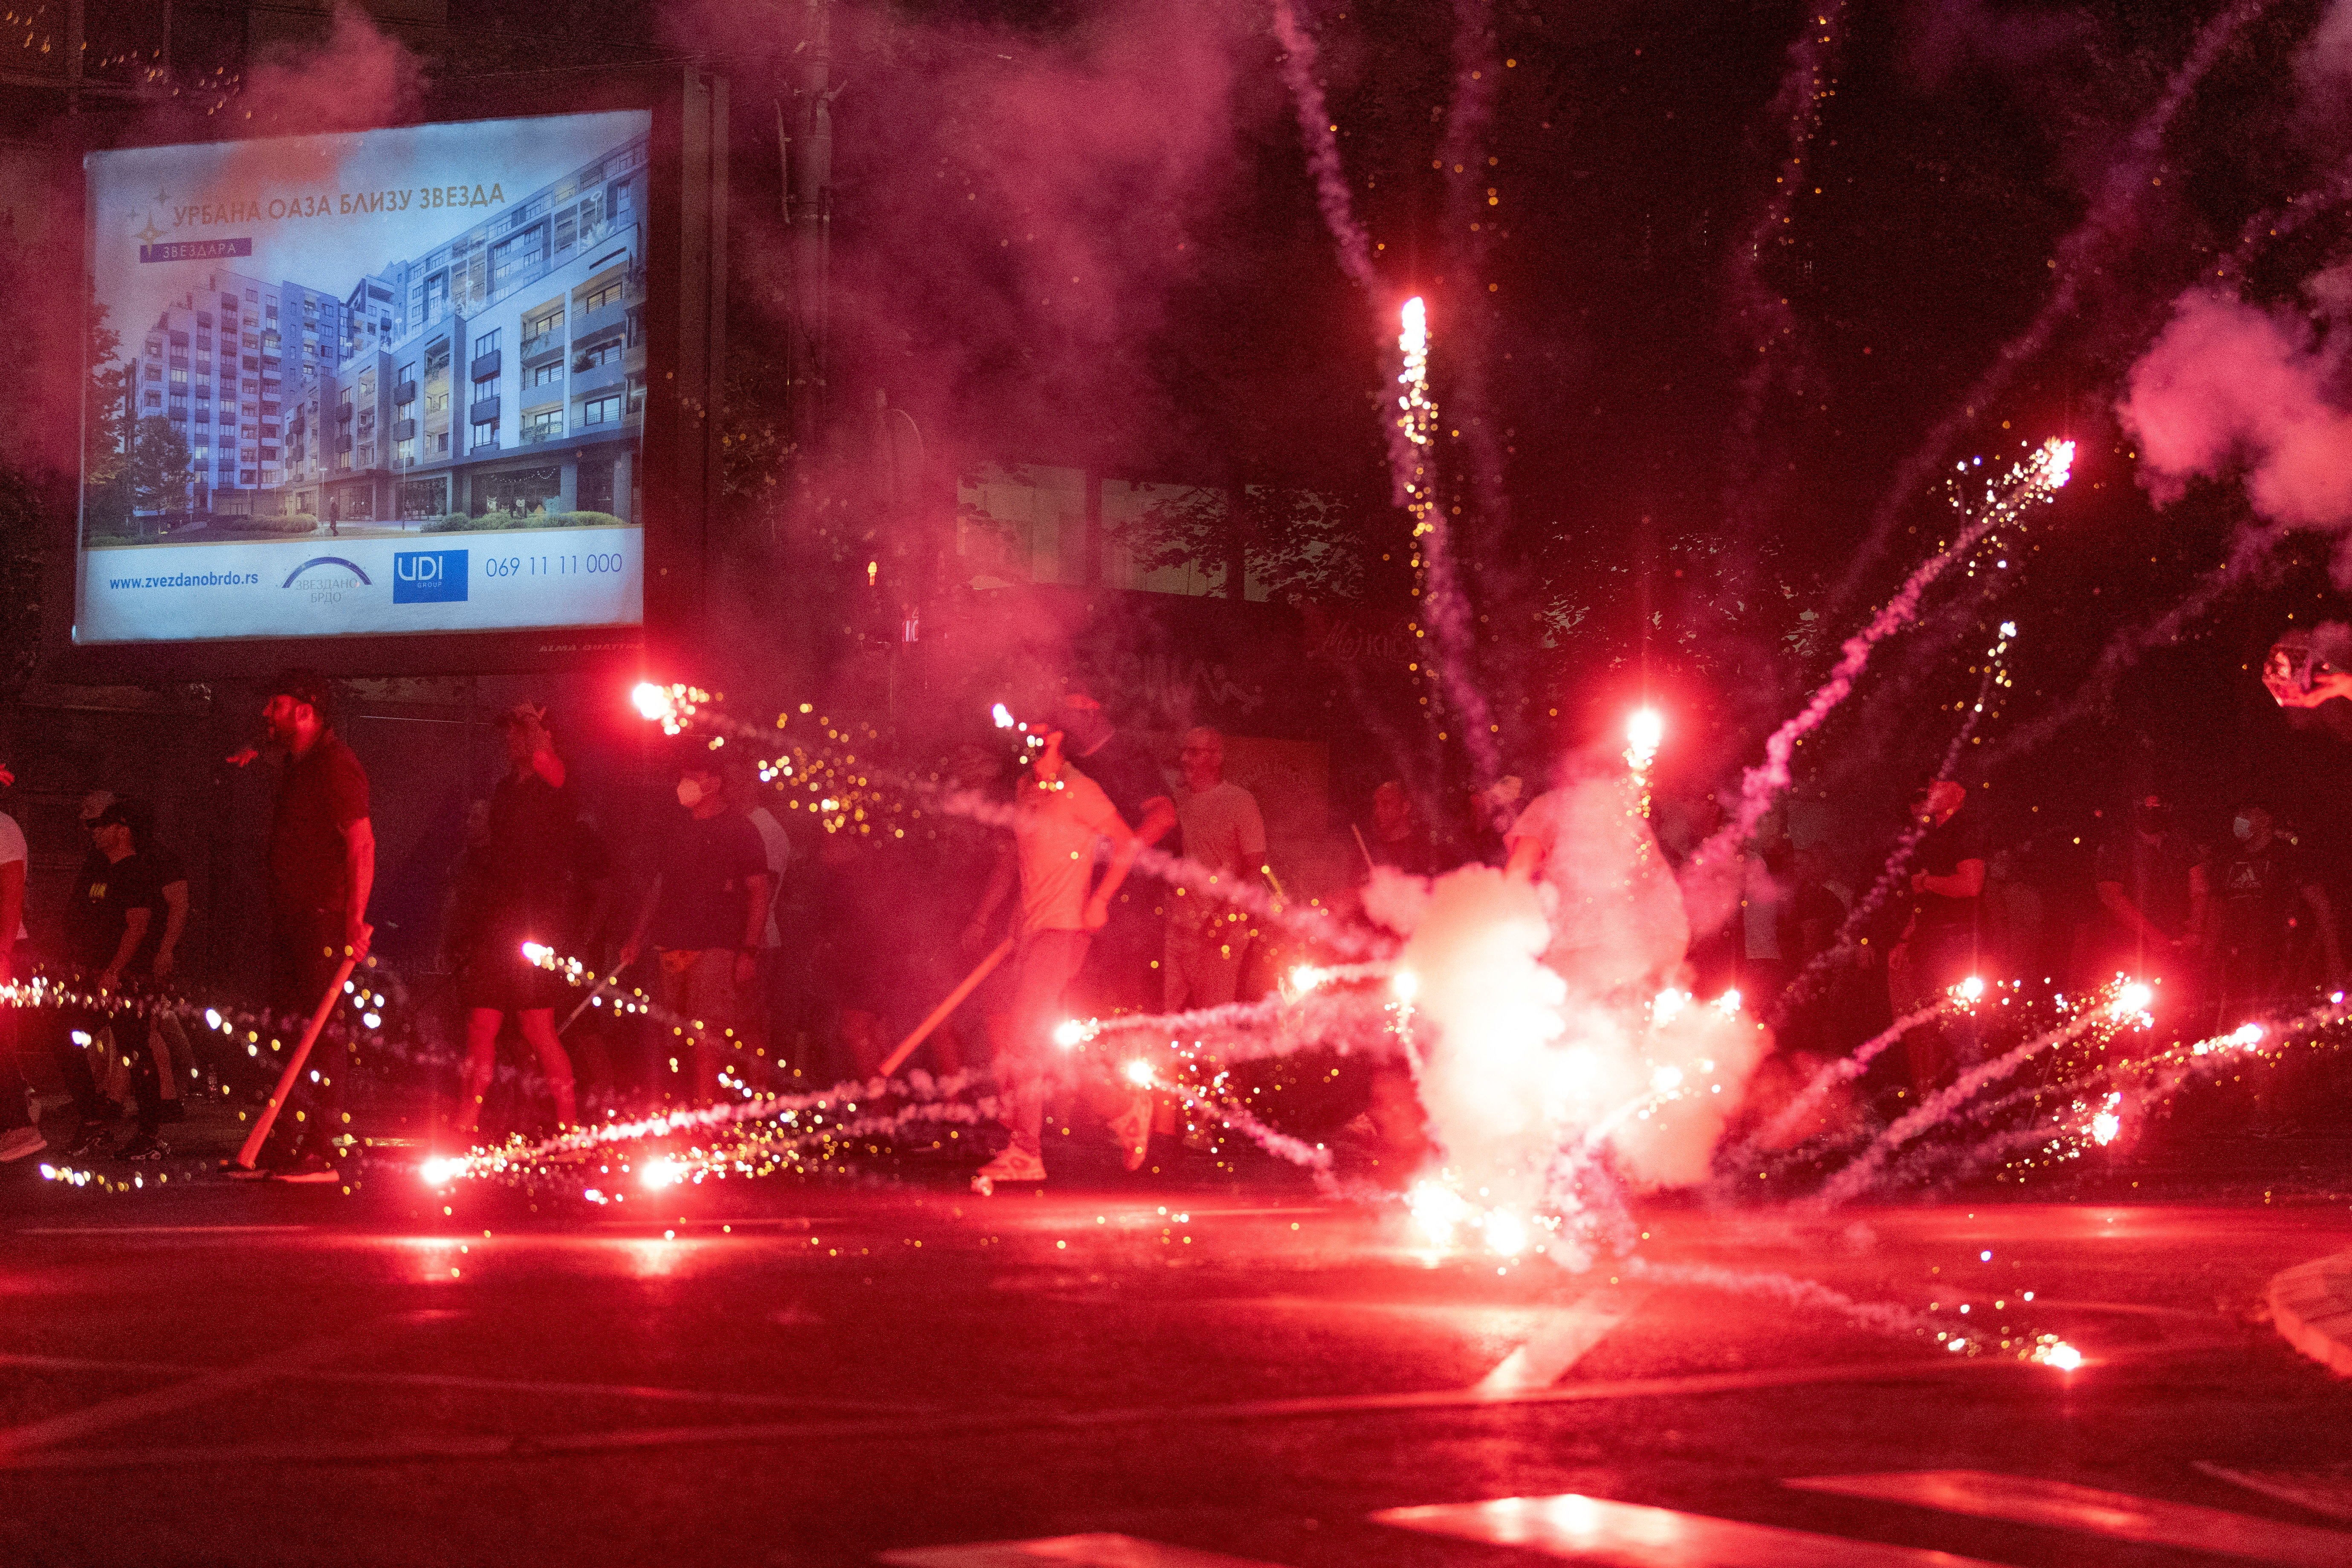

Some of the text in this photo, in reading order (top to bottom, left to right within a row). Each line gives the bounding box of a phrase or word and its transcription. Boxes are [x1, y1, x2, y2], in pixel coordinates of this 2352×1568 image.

[173, 183, 505, 227] УРБАНА ОАЗА БЛИЗУ ЗВЕЗДА
[163, 243, 236, 258] ЗВЕЗДАРА
[398, 555, 443, 581] UDI
[486, 553, 622, 577] 069 11 11 000
[110, 571, 258, 589] www.zvezdanobrdo.rs
[296, 578, 358, 590] ЗВЕЗДАНО
[311, 592, 342, 604] БРДО
[538, 644, 577, 652] ALMA
